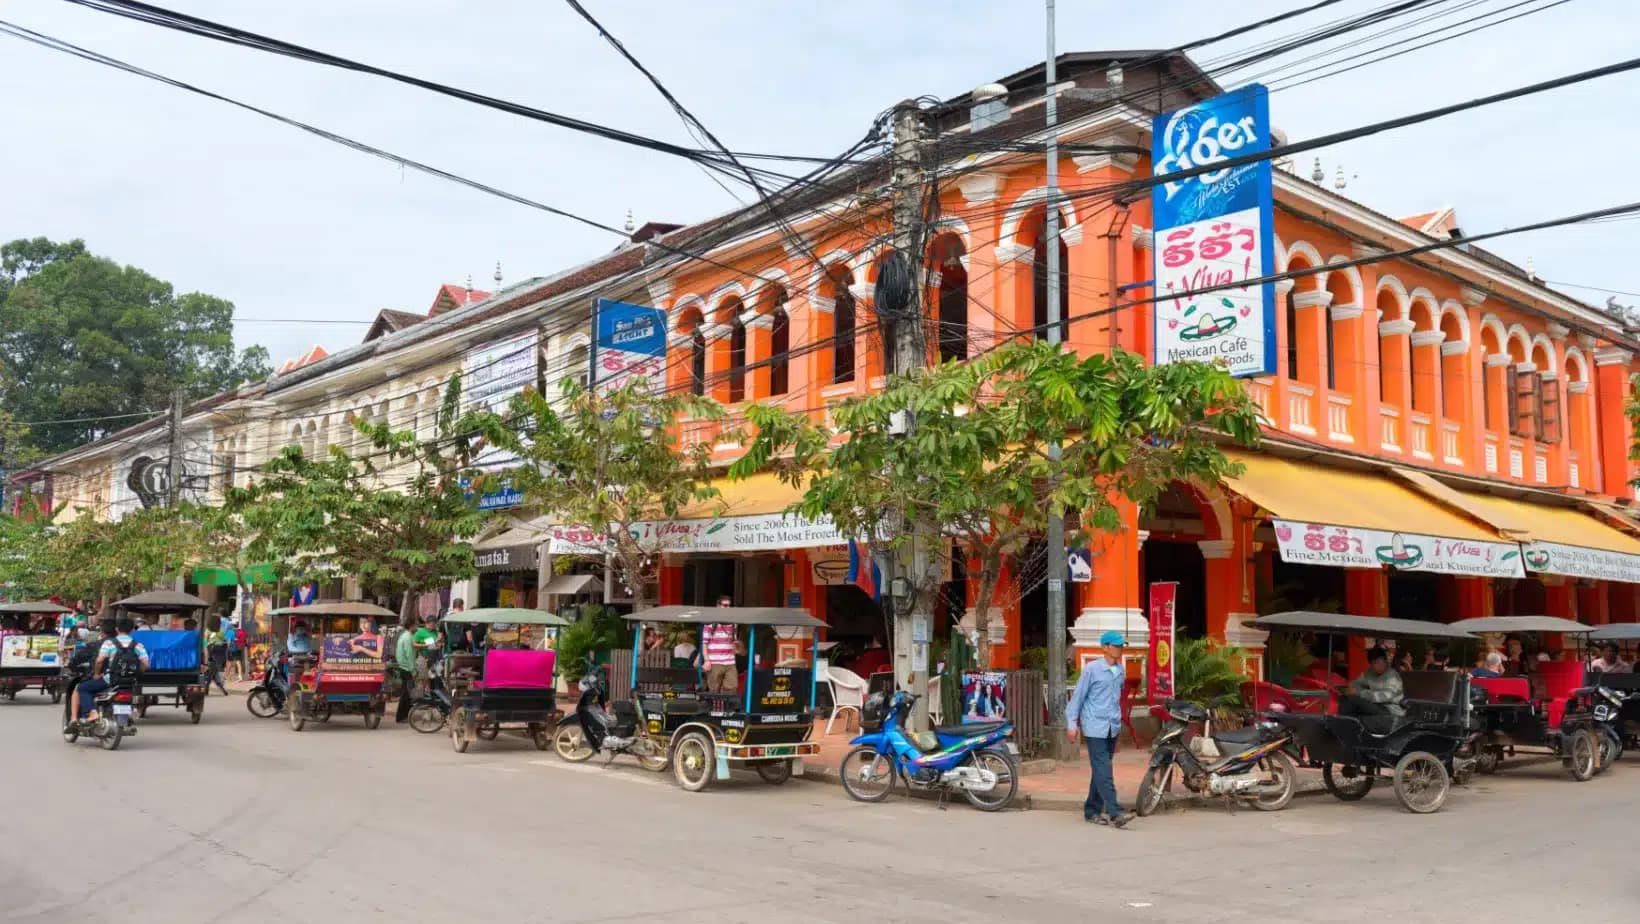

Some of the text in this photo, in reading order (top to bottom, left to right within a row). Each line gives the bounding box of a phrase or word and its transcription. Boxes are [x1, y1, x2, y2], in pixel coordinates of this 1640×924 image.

[1154, 115, 1258, 202] Tiger
[1168, 338, 1247, 361] Mexican Café
[734, 521, 761, 531] Since
[734, 533, 754, 544] Sold
[757, 532, 775, 543] The
[777, 531, 802, 543] Most
[1286, 548, 1372, 564] Fine Mexican
